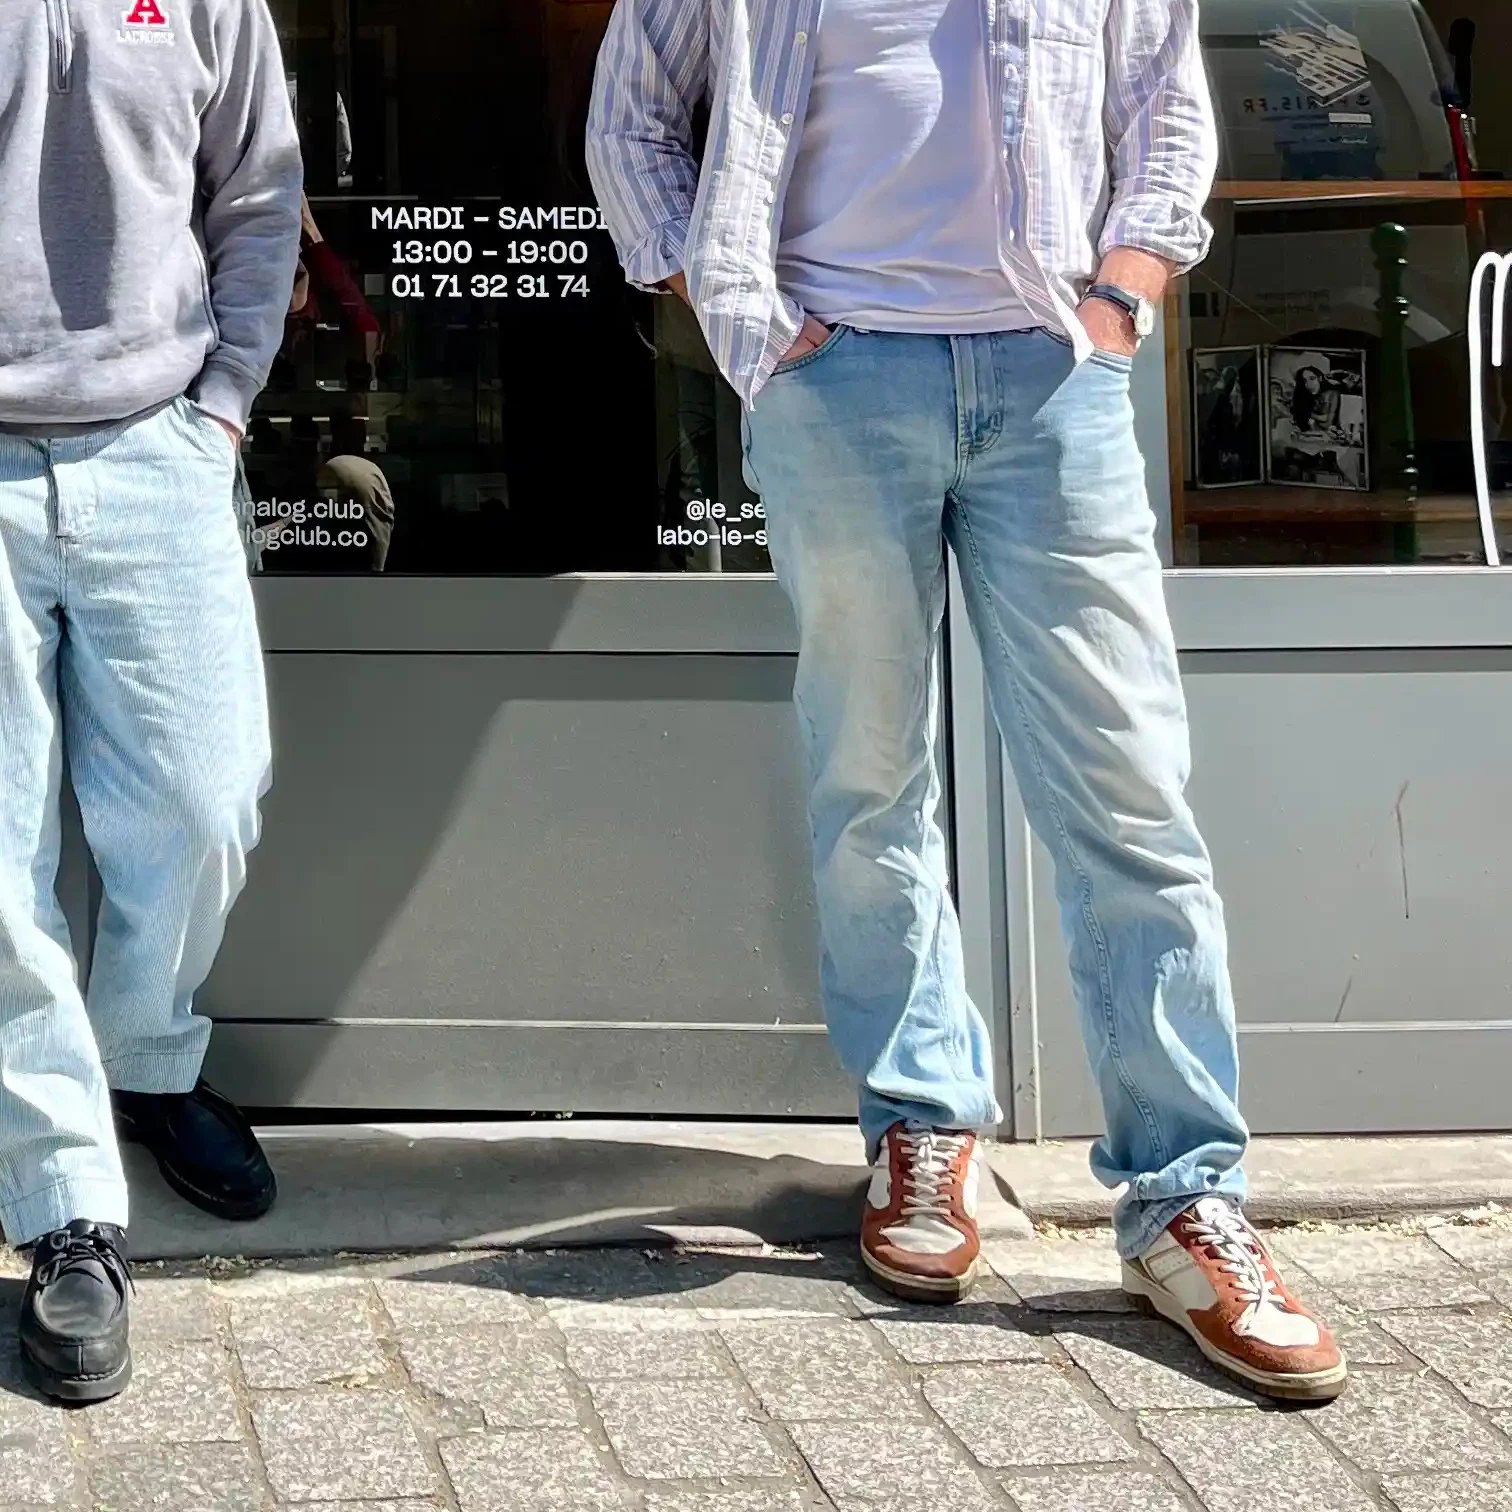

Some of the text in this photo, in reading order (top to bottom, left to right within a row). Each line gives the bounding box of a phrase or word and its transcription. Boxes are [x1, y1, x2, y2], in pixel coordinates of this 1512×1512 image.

[371, 206, 465, 230] MARDI
[391, 240, 473, 264] 13:00
[506, 240, 588, 264] 19:00
[391, 274, 591, 298] 01 71 32 31 74
